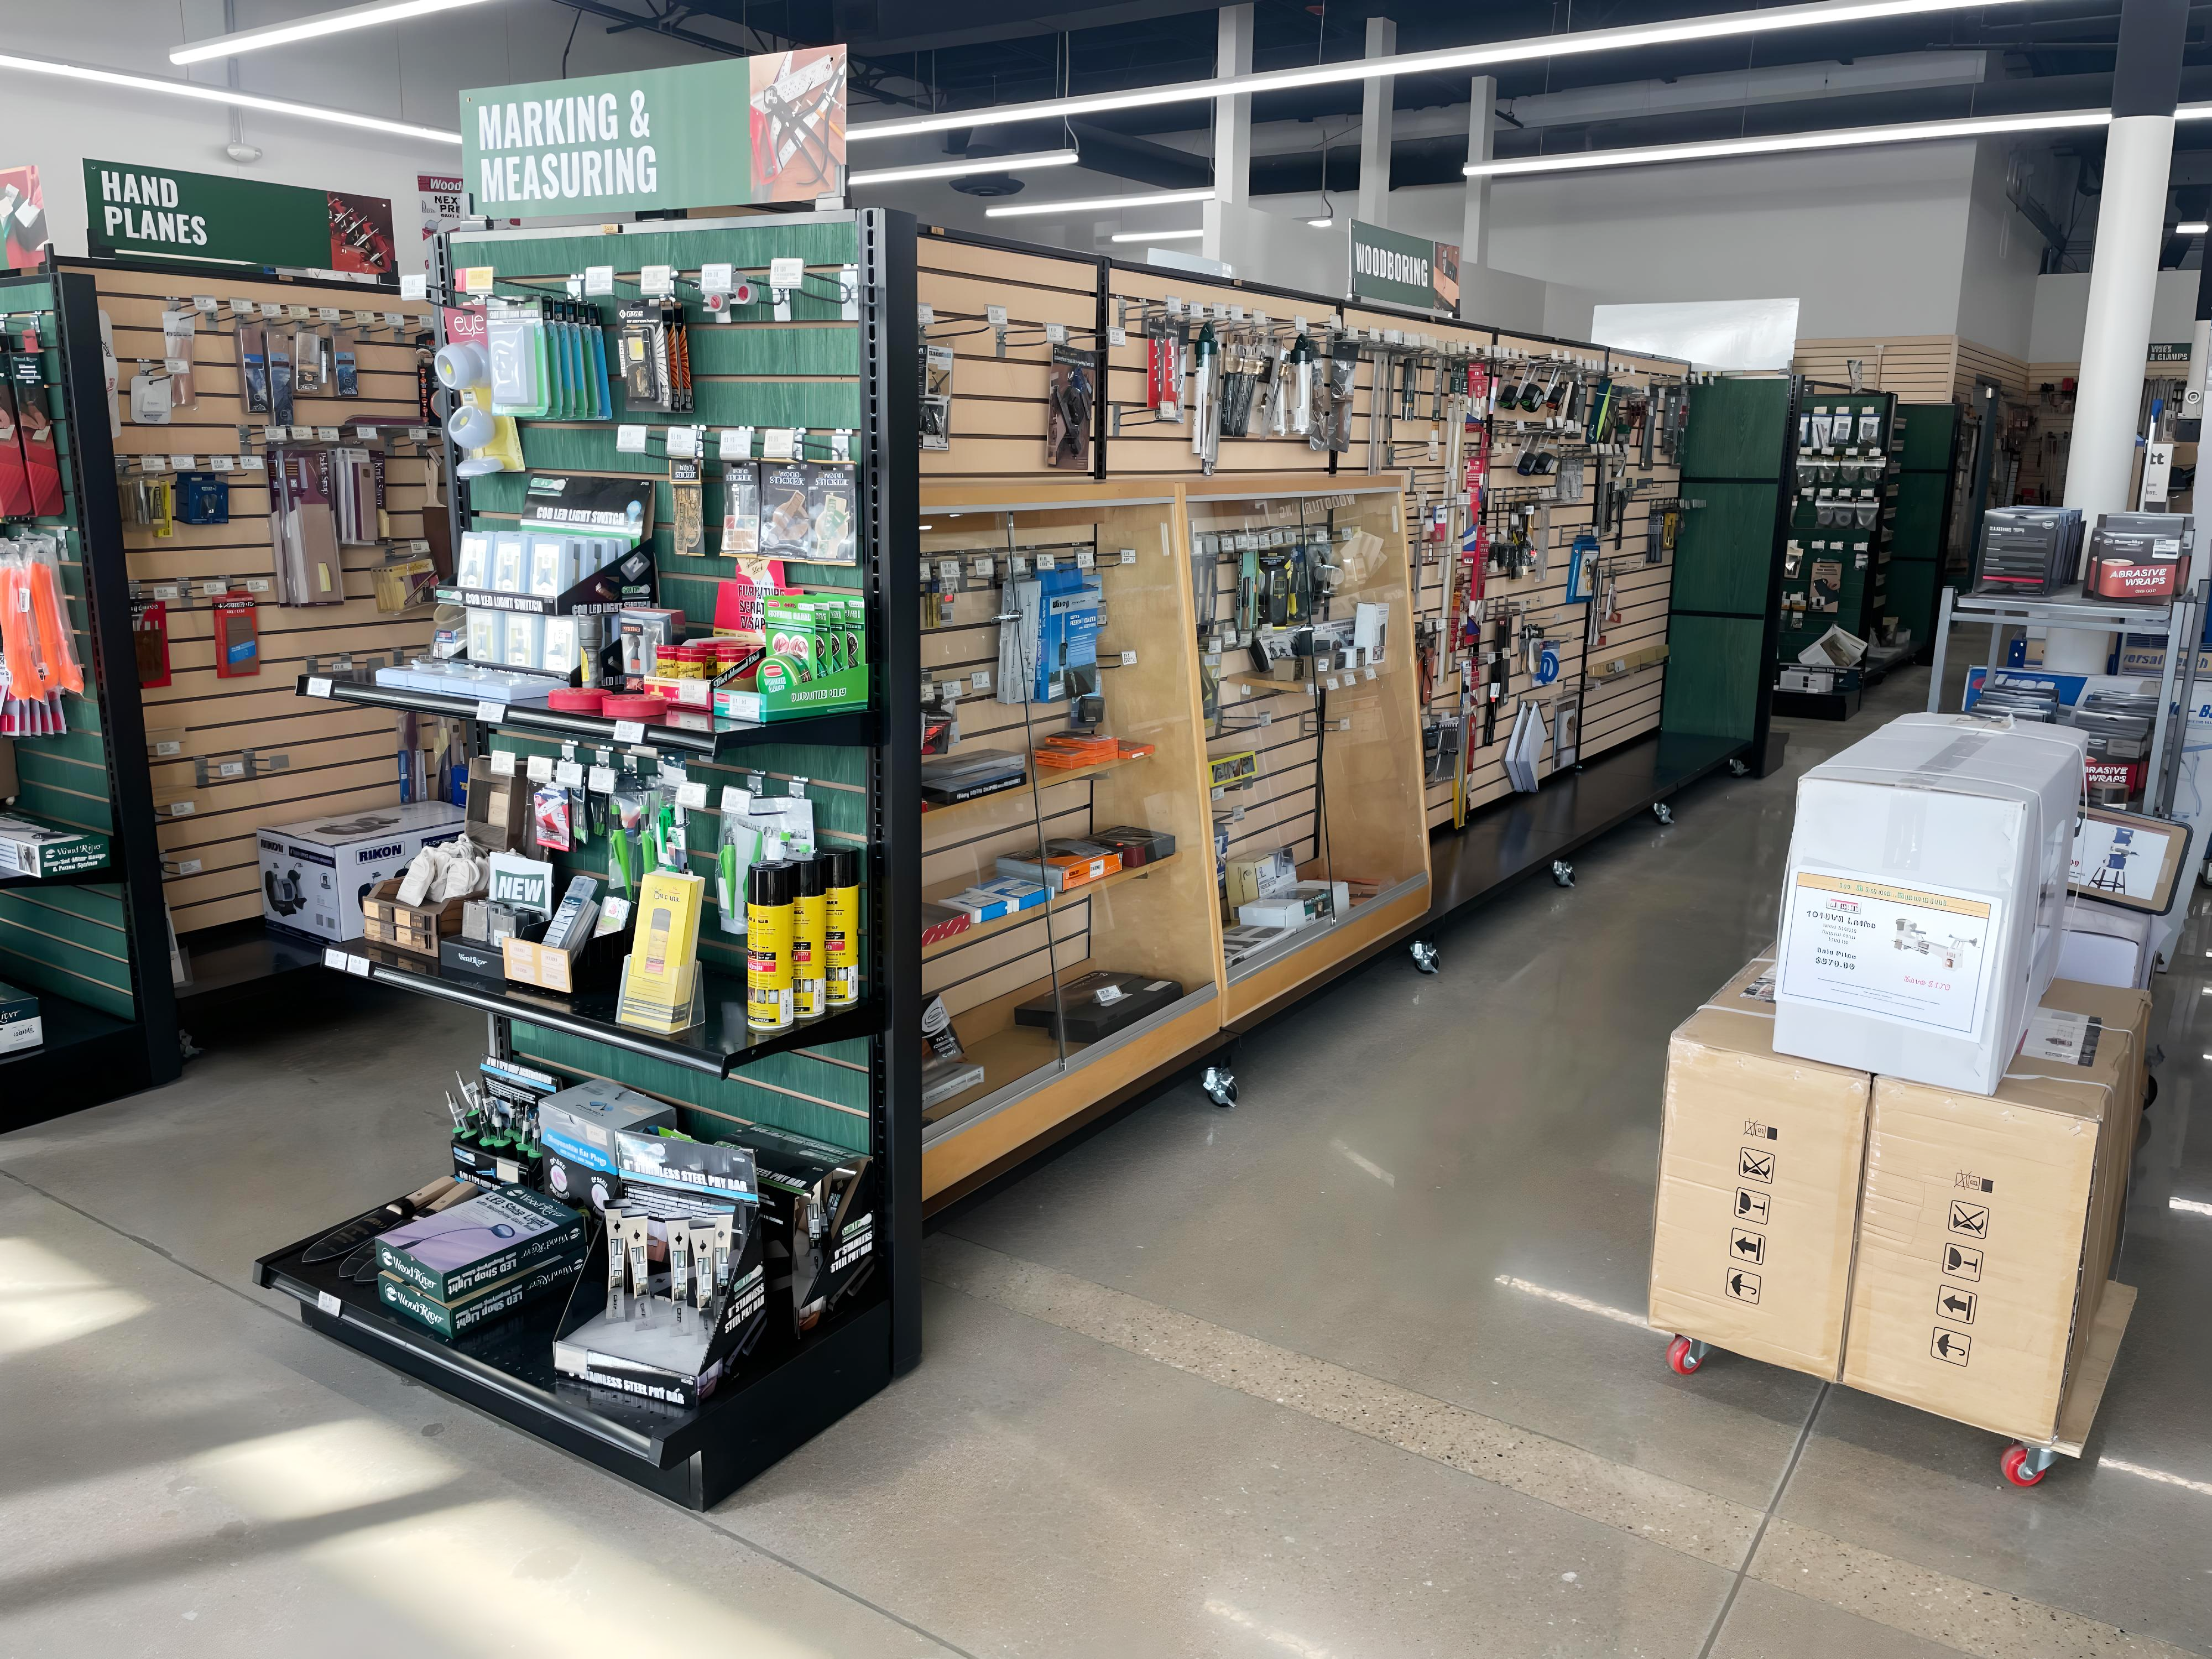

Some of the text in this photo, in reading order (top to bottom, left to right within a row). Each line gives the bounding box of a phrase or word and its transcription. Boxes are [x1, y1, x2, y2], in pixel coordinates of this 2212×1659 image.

[478, 90, 650, 151] MARKING &
[481, 146, 657, 203] MEASURING
[101, 170, 179, 208] HAND
[430, 178, 463, 191] Wood
[435, 196, 460, 204] NEX
[105, 205, 207, 246] PLANES
[1355, 242, 1428, 288] WOODBORING
[454, 315, 484, 337] eye
[554, 508, 568, 520] LED
[568, 509, 592, 523] LIGHT
[2110, 568, 2167, 579] ABRASIVE
[2125, 578, 2167, 586] WRAPS
[739, 600, 765, 614] SCRAT
[740, 615, 766, 630] DISAP
[359, 844, 401, 862] RIKON
[498, 875, 544, 902] NEW
[681, 1171, 707, 1185] STEEL
